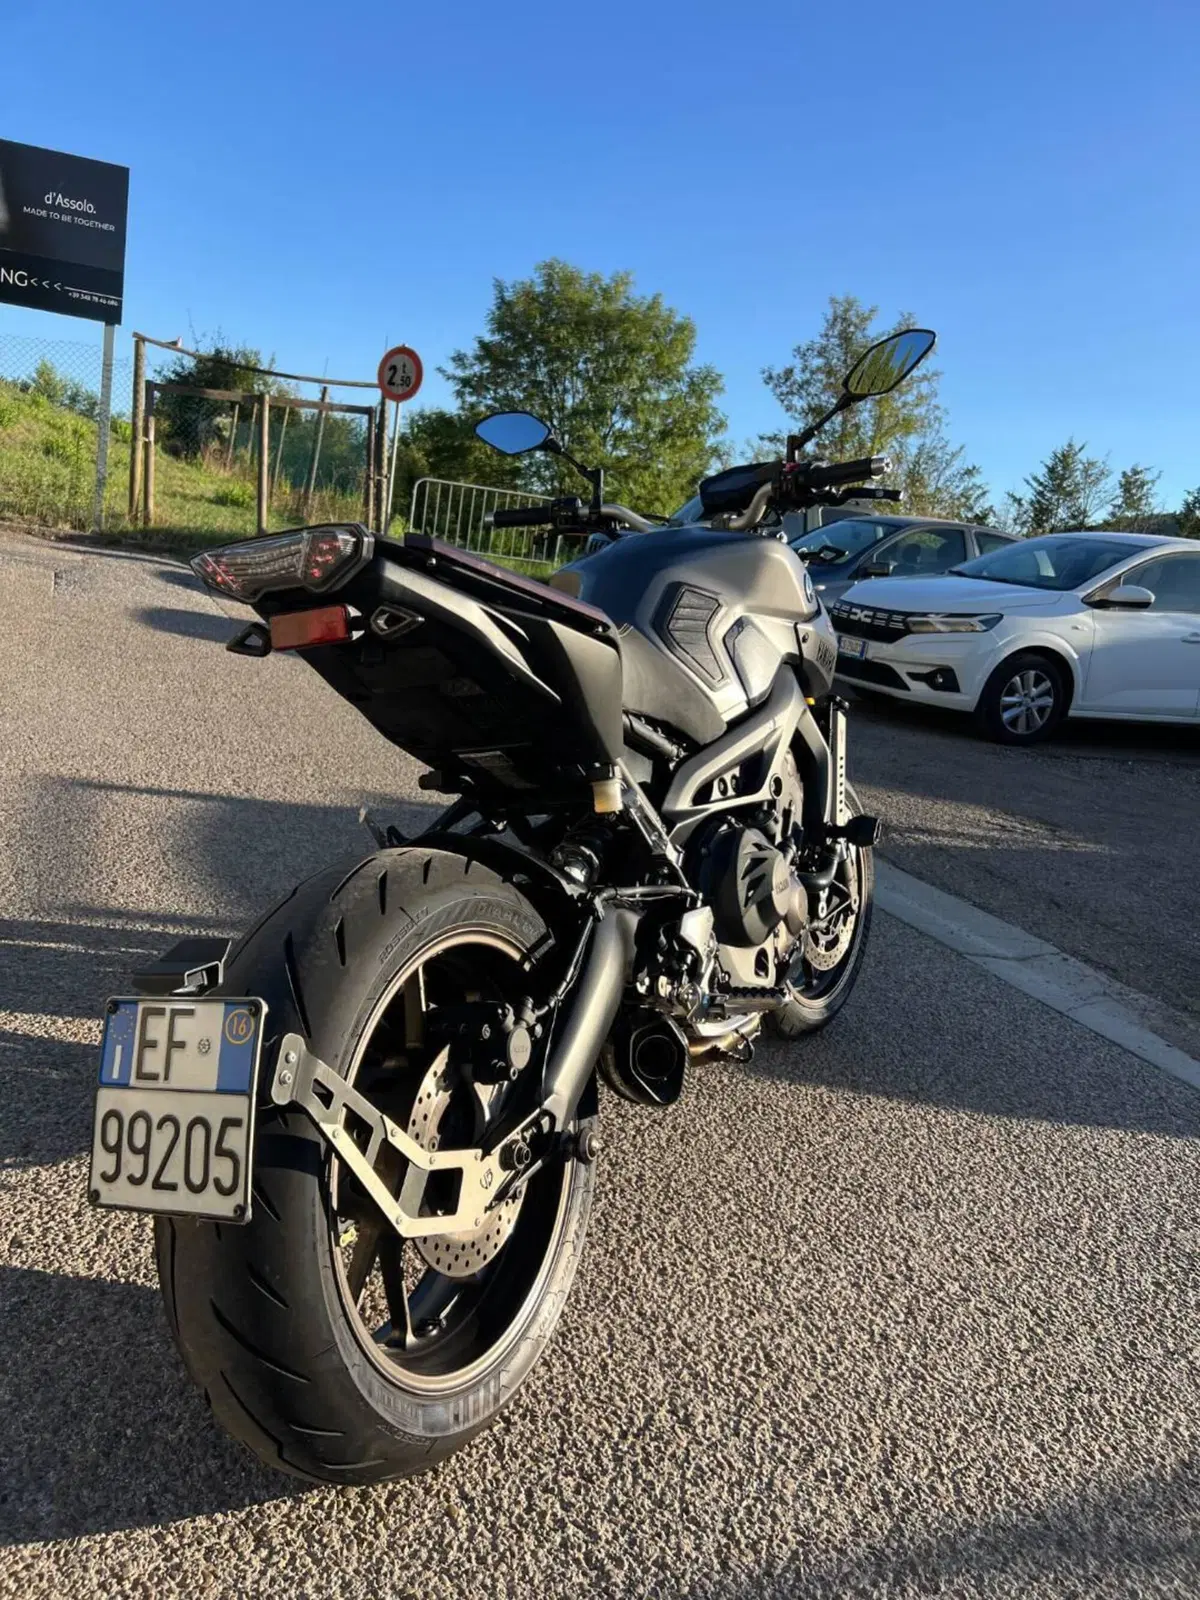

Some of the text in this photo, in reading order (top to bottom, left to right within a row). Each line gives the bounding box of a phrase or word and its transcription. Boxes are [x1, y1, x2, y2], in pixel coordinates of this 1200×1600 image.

[23, 206, 115, 231] MADE TO BE TOGETHER
[136, 1006, 195, 1081] EF
[232, 1015, 247, 1035] 16
[100, 1108, 243, 1196] 99205
